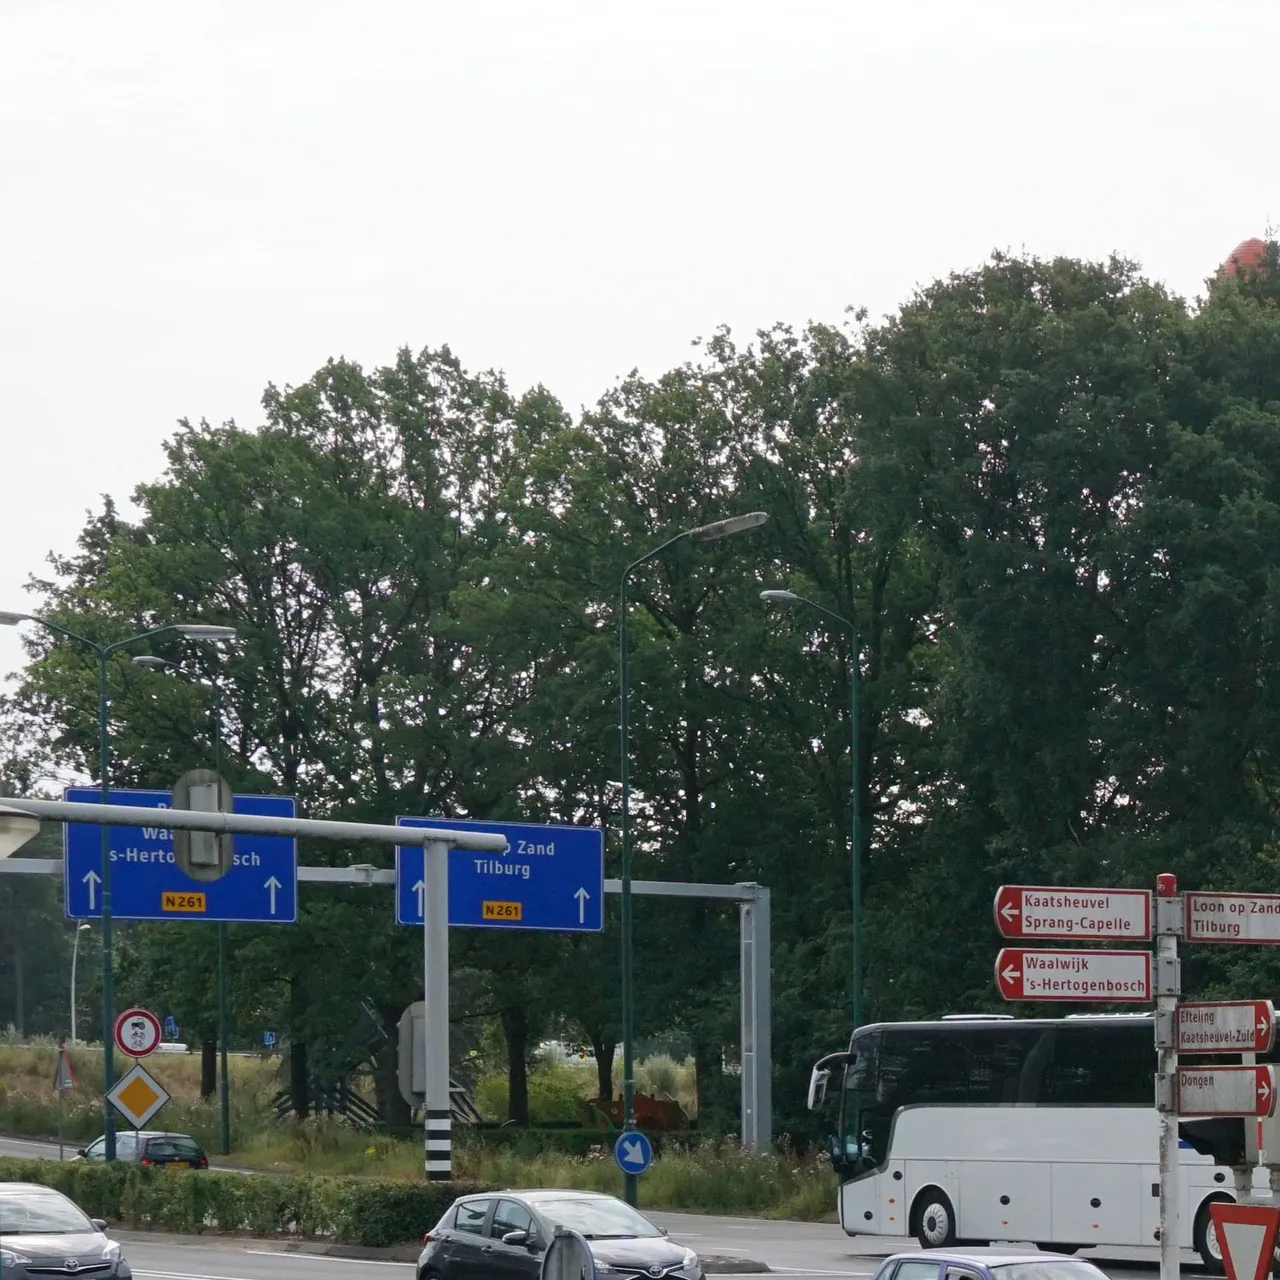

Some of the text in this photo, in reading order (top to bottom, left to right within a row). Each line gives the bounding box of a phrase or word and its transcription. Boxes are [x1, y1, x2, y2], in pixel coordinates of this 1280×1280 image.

[517, 841, 555, 856] Zand
[474, 860, 530, 879] Tilburg
[166, 895, 204, 907] N 261
[1025, 895, 1110, 910] Kaatsheuvel
[486, 905, 520, 916] N 261
[1193, 902, 1224, 914] Loon
[1229, 905, 1246, 917] op
[1025, 915, 1131, 932] Sprang-Capelle
[1193, 920, 1240, 936] Tilburg
[1026, 957, 1089, 974] Waalwijk
[1026, 979, 1145, 995] 's-Hertogenbosch
[1180, 1011, 1215, 1026] Efteling
[1180, 1031, 1256, 1044] Kaatsheuvel-Zuid
[1181, 1074, 1214, 1089] Dongen
